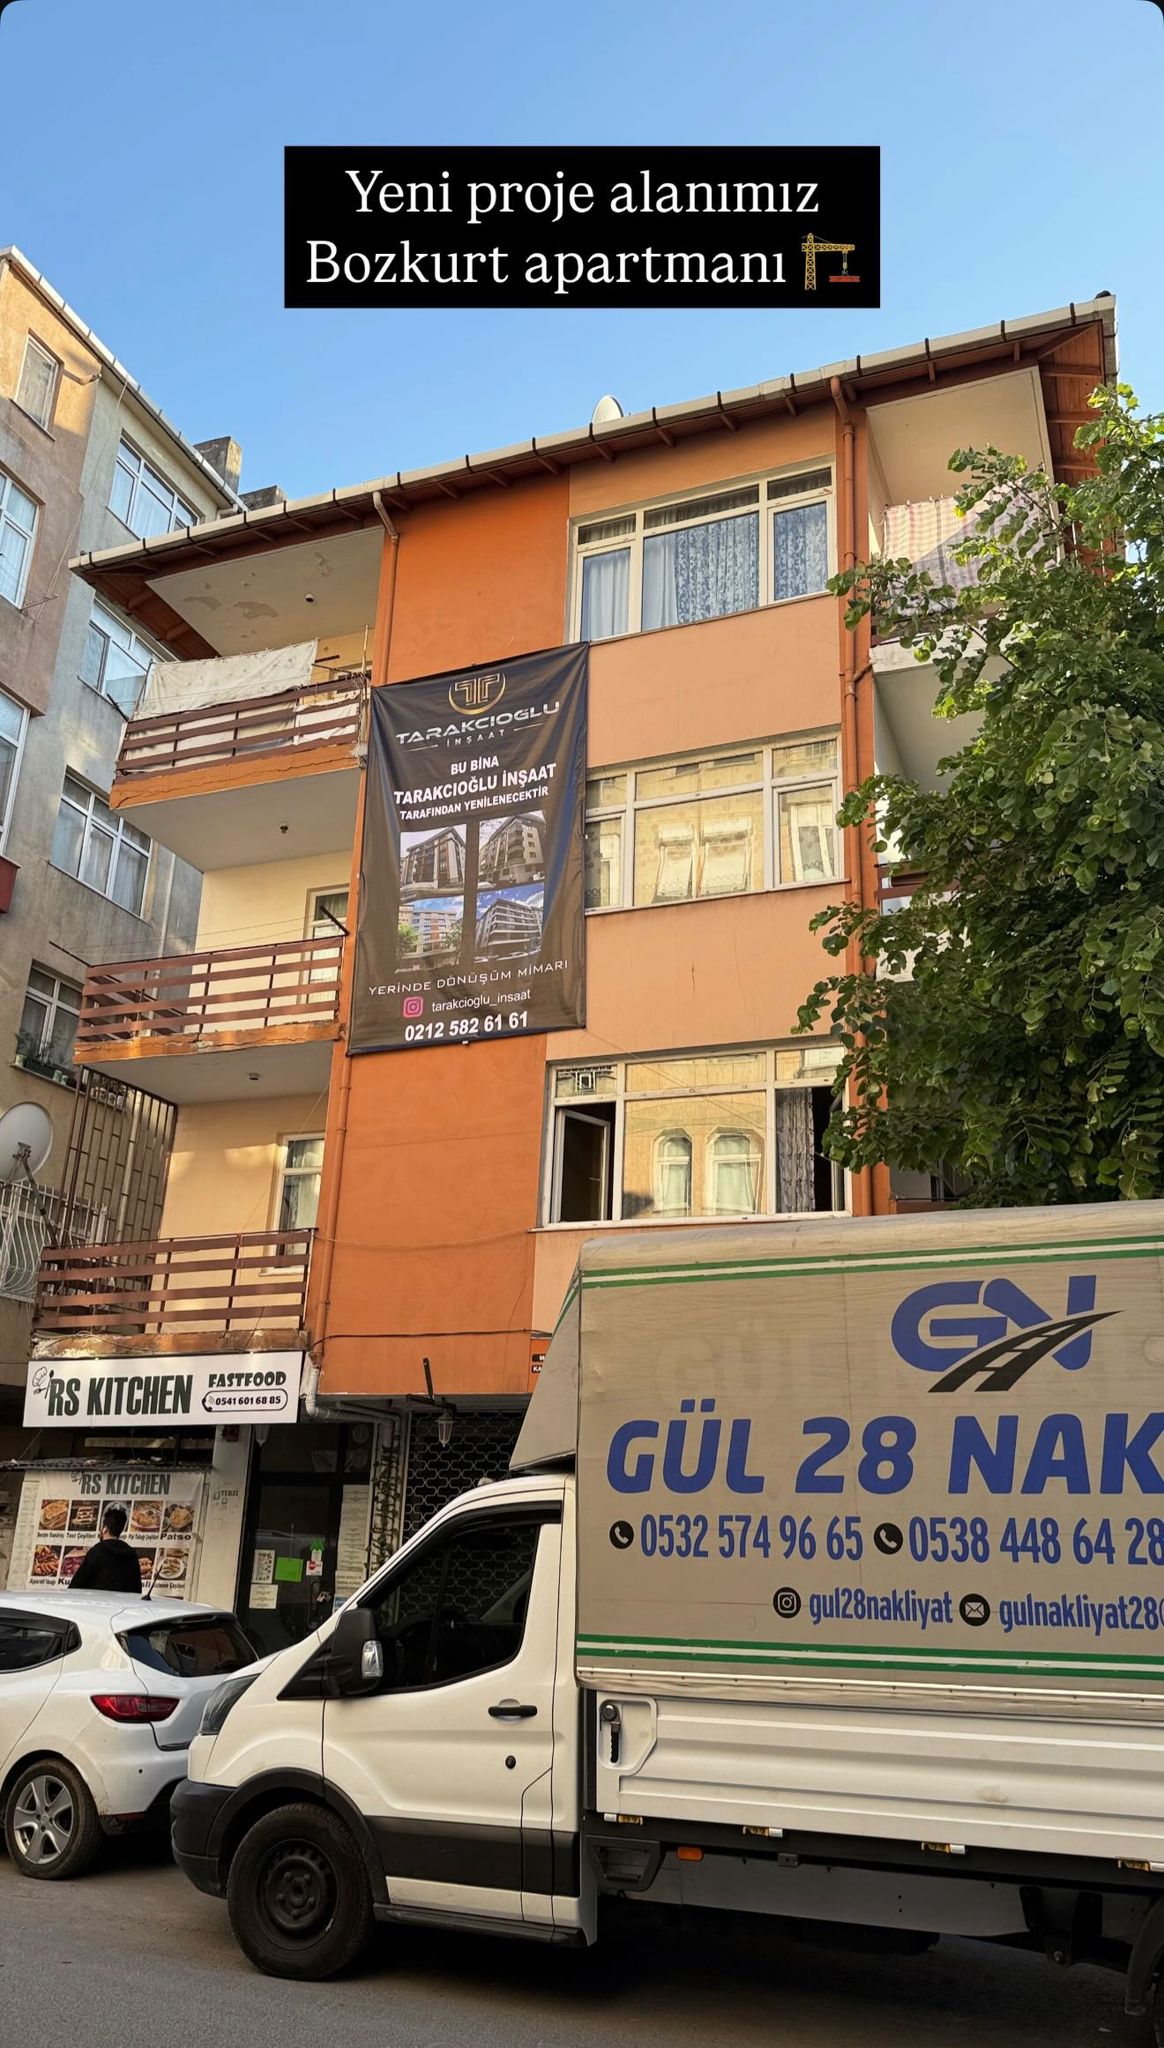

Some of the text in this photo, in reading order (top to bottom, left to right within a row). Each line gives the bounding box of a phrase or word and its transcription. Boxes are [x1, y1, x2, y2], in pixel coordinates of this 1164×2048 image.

[447, 730, 504, 747] İNŞAAT
[451, 756, 498, 775] BU BİNA
[394, 763, 556, 804] TARAKCIOĞLU İNŞAAT
[400, 785, 548, 820] TARAFINDAN YENİLENECEKTİR
[369, 960, 568, 995] YERİNDE DÖNÜŞÜM MİMARI
[432, 989, 531, 1012] tarakcioglu_insaat
[405, 1011, 527, 1041] 0212 582 61 61
[48, 1374, 193, 1416] RS KITCHEN
[208, 1371, 286, 1388] FASTFOOD
[270, 1396, 281, 1404] 85
[606, 1398, 1164, 1495] GÜL 28 NAK
[81, 1474, 171, 1495] RS KITCHEN
[640, 1514, 863, 1560] 0532 574 96 65
[909, 1516, 1164, 1566] 0538 448 64 28
[809, 1588, 953, 1630] gul28nakliyat
[999, 1593, 1164, 1636] gulnakliyat28
